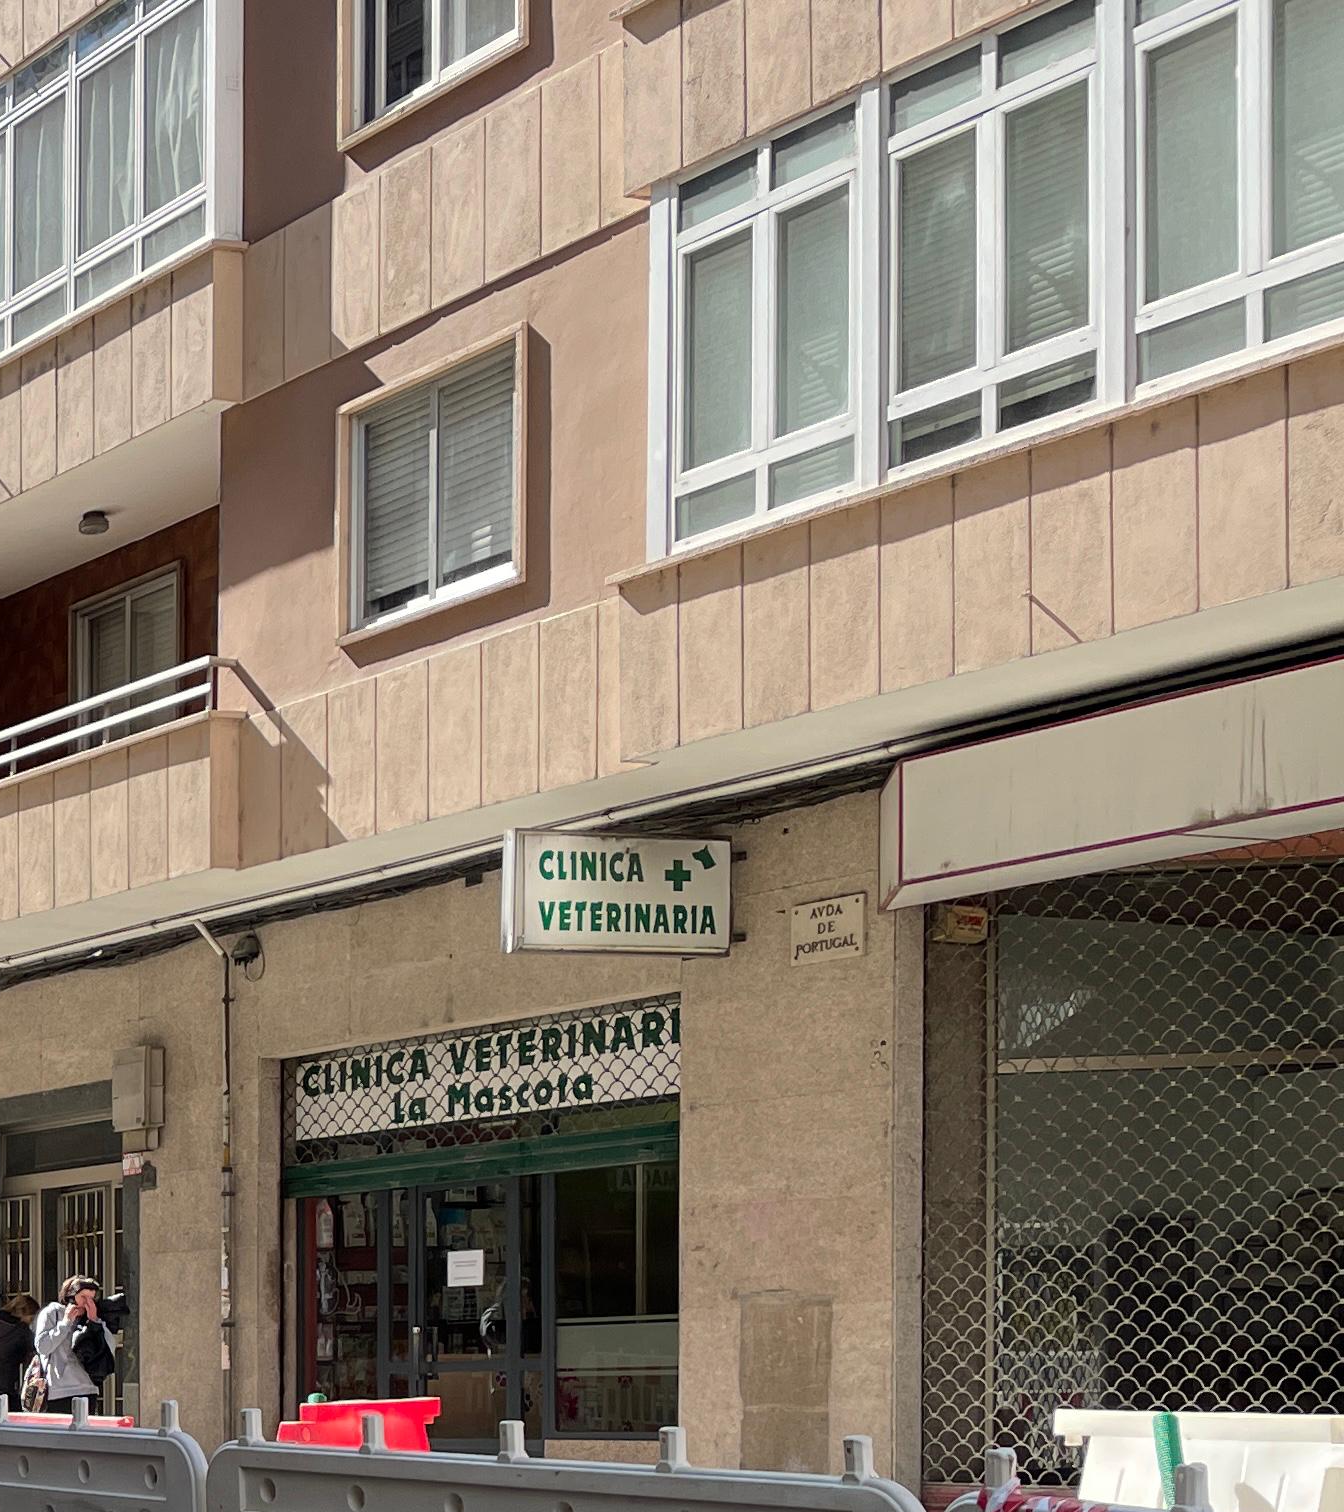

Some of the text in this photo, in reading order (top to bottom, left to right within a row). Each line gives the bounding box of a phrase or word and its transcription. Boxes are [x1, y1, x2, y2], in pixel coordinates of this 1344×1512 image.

[538, 849, 645, 884] CLINICA
[537, 901, 716, 936] VETERINARIA
[810, 904, 844, 919] AVDA
[817, 921, 836, 934] DE
[795, 934, 858, 959] PORTUGAL
[302, 1049, 430, 1098] CLINICA
[447, 1072, 595, 1117] Mascota
